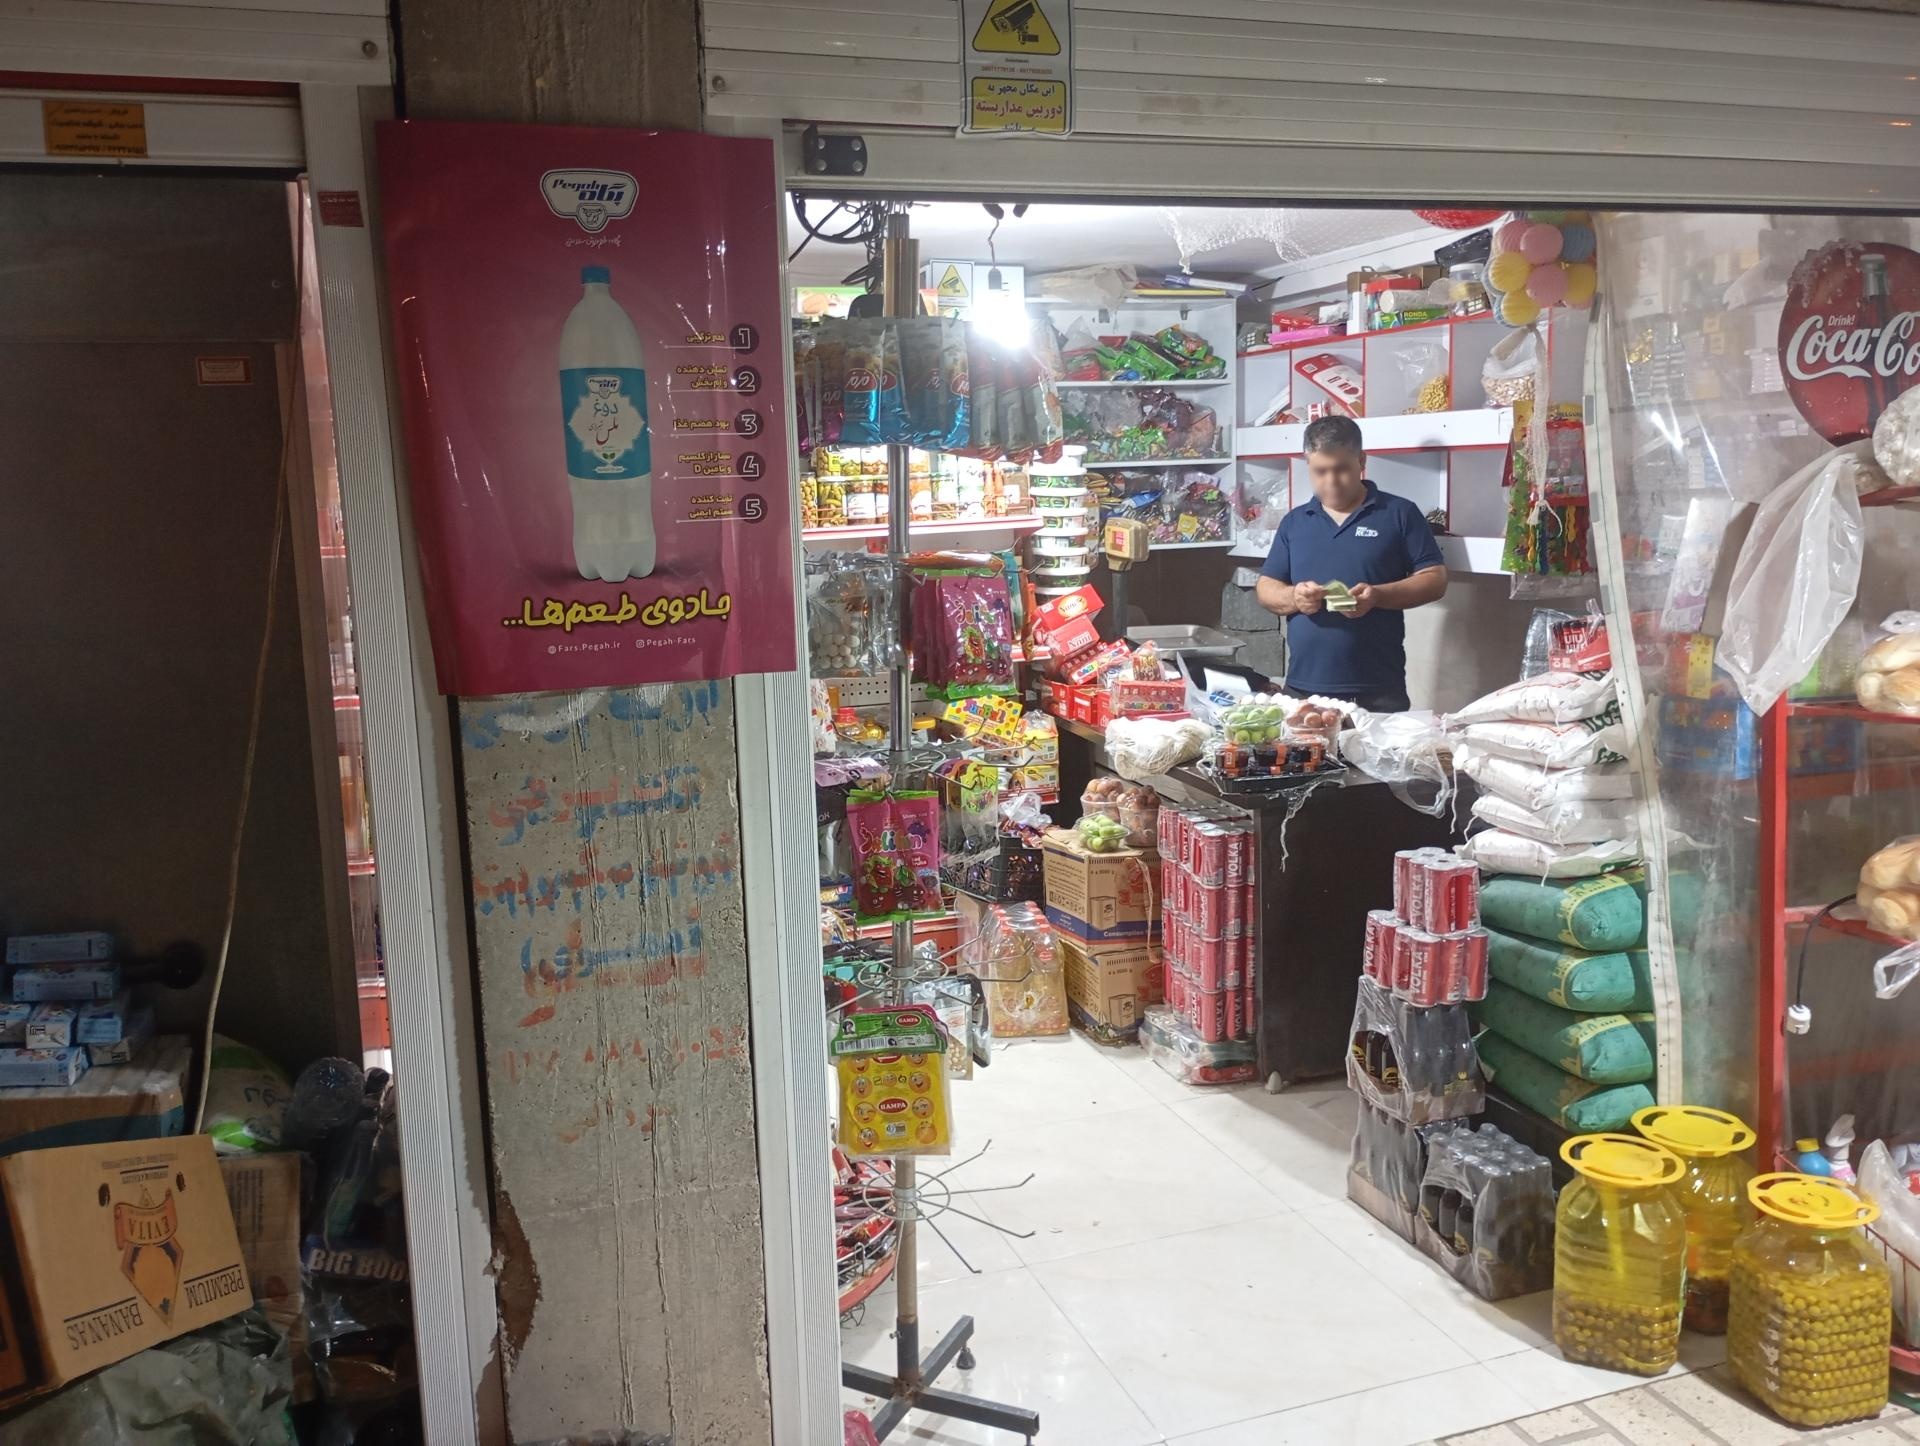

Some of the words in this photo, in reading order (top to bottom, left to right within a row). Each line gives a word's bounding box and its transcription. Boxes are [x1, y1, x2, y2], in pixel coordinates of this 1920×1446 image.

[552, 179, 600, 191] Pegah
[1828, 314, 1856, 326] Drink!
[739, 328, 750, 349] 1
[676, 366, 705, 374] دهنده
[739, 371, 755, 391] 2
[593, 398, 618, 418] دوغ
[742, 414, 757, 435] 3
[678, 452, 706, 463] کلسیم
[743, 455, 759, 476] 4
[694, 464, 701, 473] D
[745, 499, 762, 519] 5
[641, 588, 732, 626] جادوی
[1227, 842, 1239, 878] VOLKA
[1411, 874, 1424, 918] VOLKA
[1364, 925, 1377, 968] VOLKA
[1411, 951, 1423, 993] VOLKA
[127, 1215, 171, 1239] EVITA
[310, 1247, 352, 1275] BIG
[184, 1269, 245, 1309] PREMIUM
[66, 1302, 142, 1351] BANANAS
